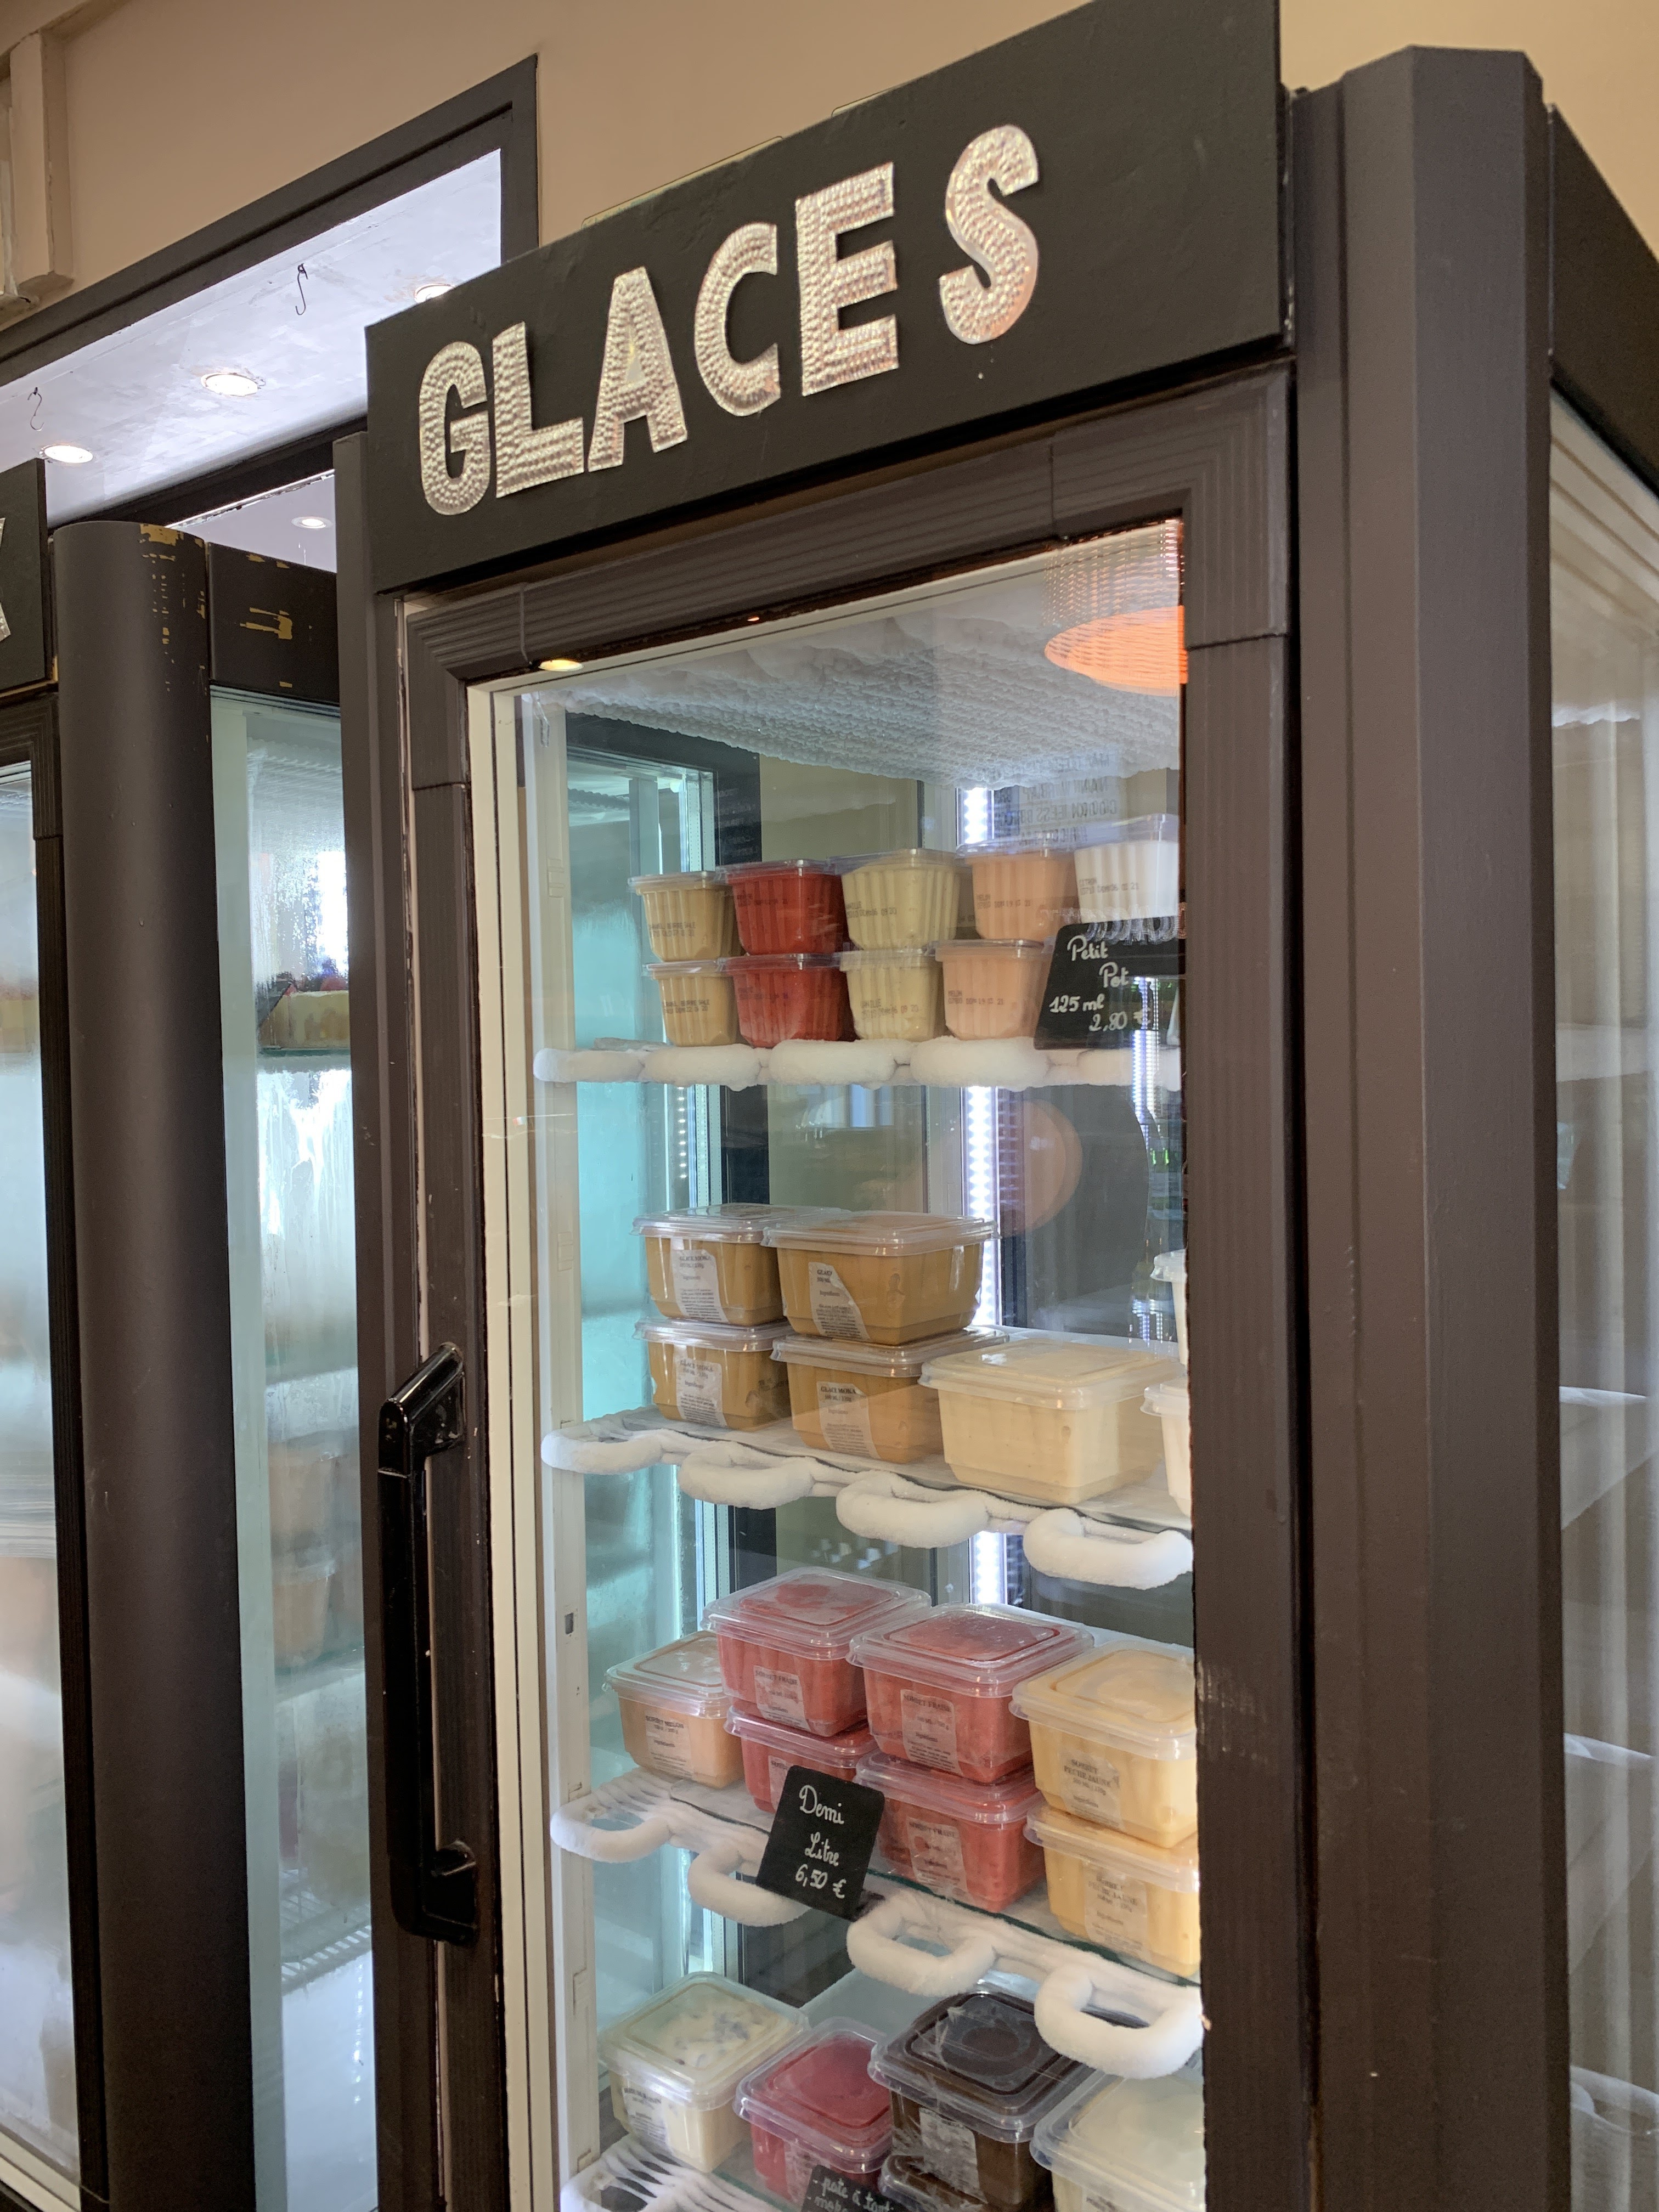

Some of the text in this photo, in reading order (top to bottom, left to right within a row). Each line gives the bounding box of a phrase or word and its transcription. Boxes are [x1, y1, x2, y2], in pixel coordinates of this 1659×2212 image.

[419, 124, 1040, 516] GLACES
[1067, 934, 1108, 961] Petit
[1099, 962, 1129, 988] Pot
[1049, 994, 1105, 1013] 125 ml
[1089, 1011, 1128, 1031] 2,80
[1071, 1758, 1098, 1774] SORBET
[799, 1785, 844, 1824] Demi
[805, 1832, 839, 1866] Litre
[795, 1864, 847, 1899] 6,50 €
